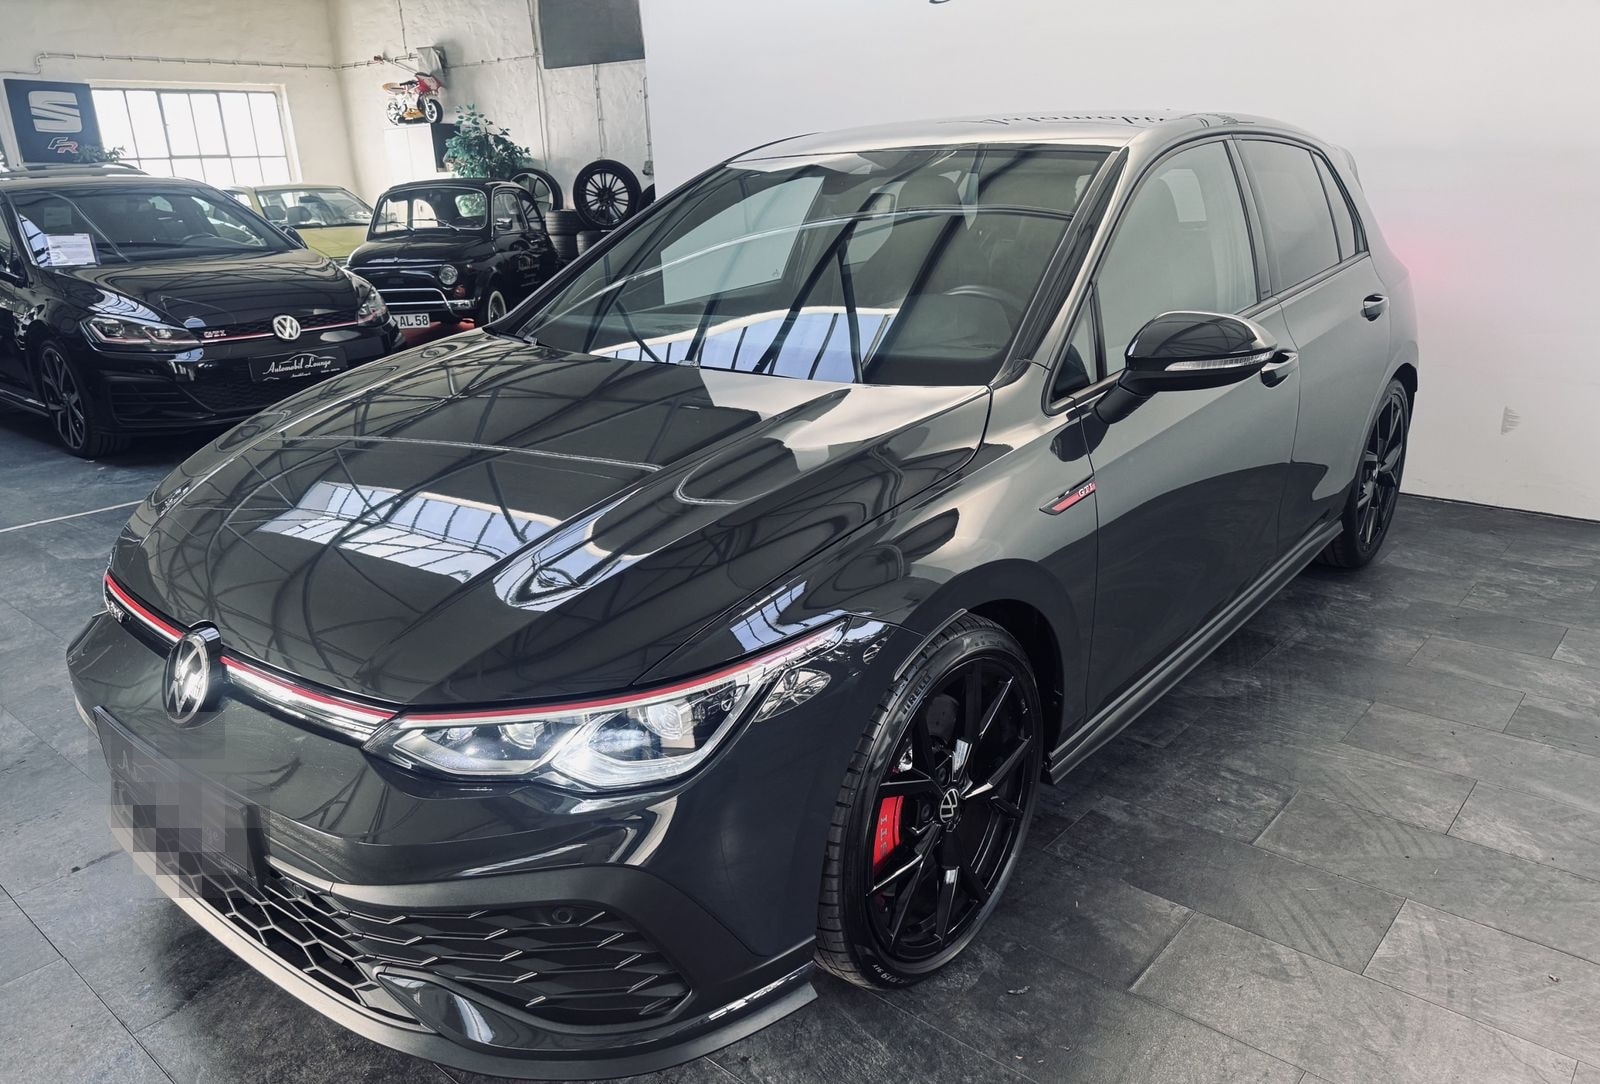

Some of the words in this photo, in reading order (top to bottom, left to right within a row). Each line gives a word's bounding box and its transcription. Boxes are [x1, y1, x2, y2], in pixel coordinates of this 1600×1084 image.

[47, 136, 79, 154] FR
[400, 315, 414, 327] AL
[415, 314, 429, 326] 58
[262, 357, 303, 375] Automobil
[305, 356, 332, 369] Lounge
[1078, 482, 1096, 497] GTI
